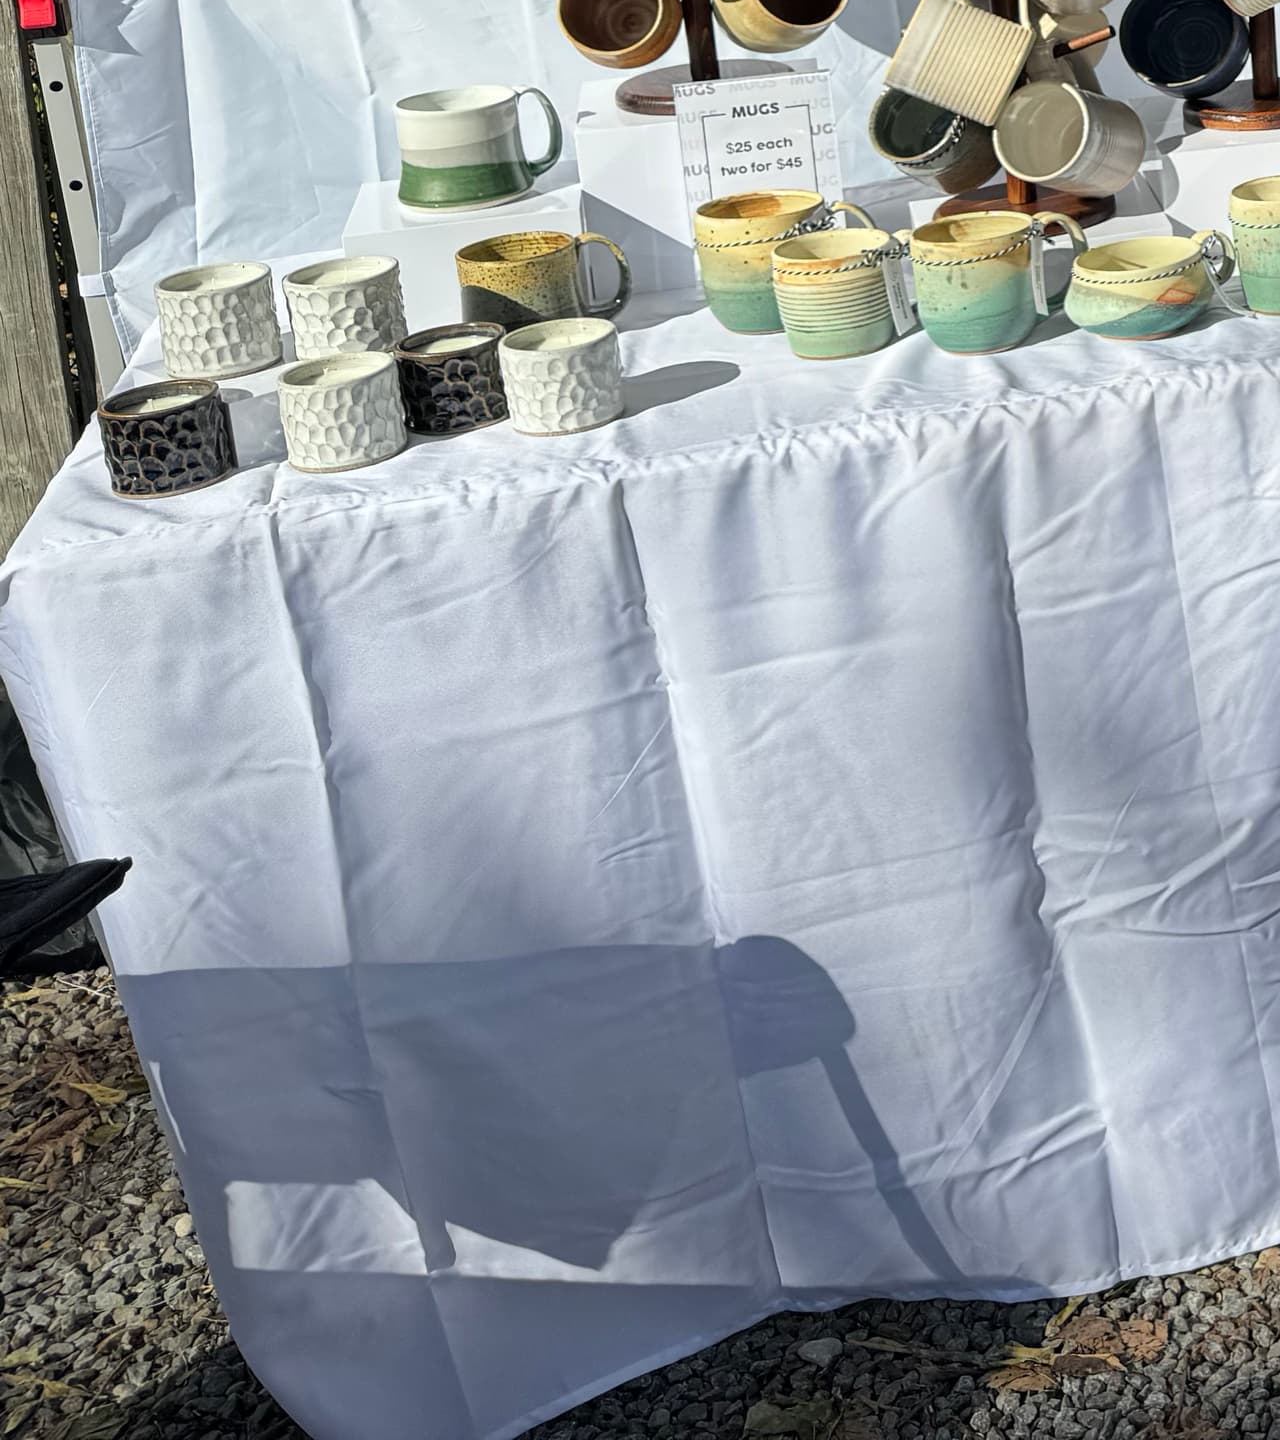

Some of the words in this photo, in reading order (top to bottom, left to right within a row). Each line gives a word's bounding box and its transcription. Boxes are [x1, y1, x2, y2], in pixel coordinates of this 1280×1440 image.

[732, 102, 781, 118] MUGS
[725, 141, 753, 155] $25
[756, 137, 793, 150] each
[720, 164, 748, 177] two
[751, 161, 772, 173] for
[776, 156, 803, 170] $45
